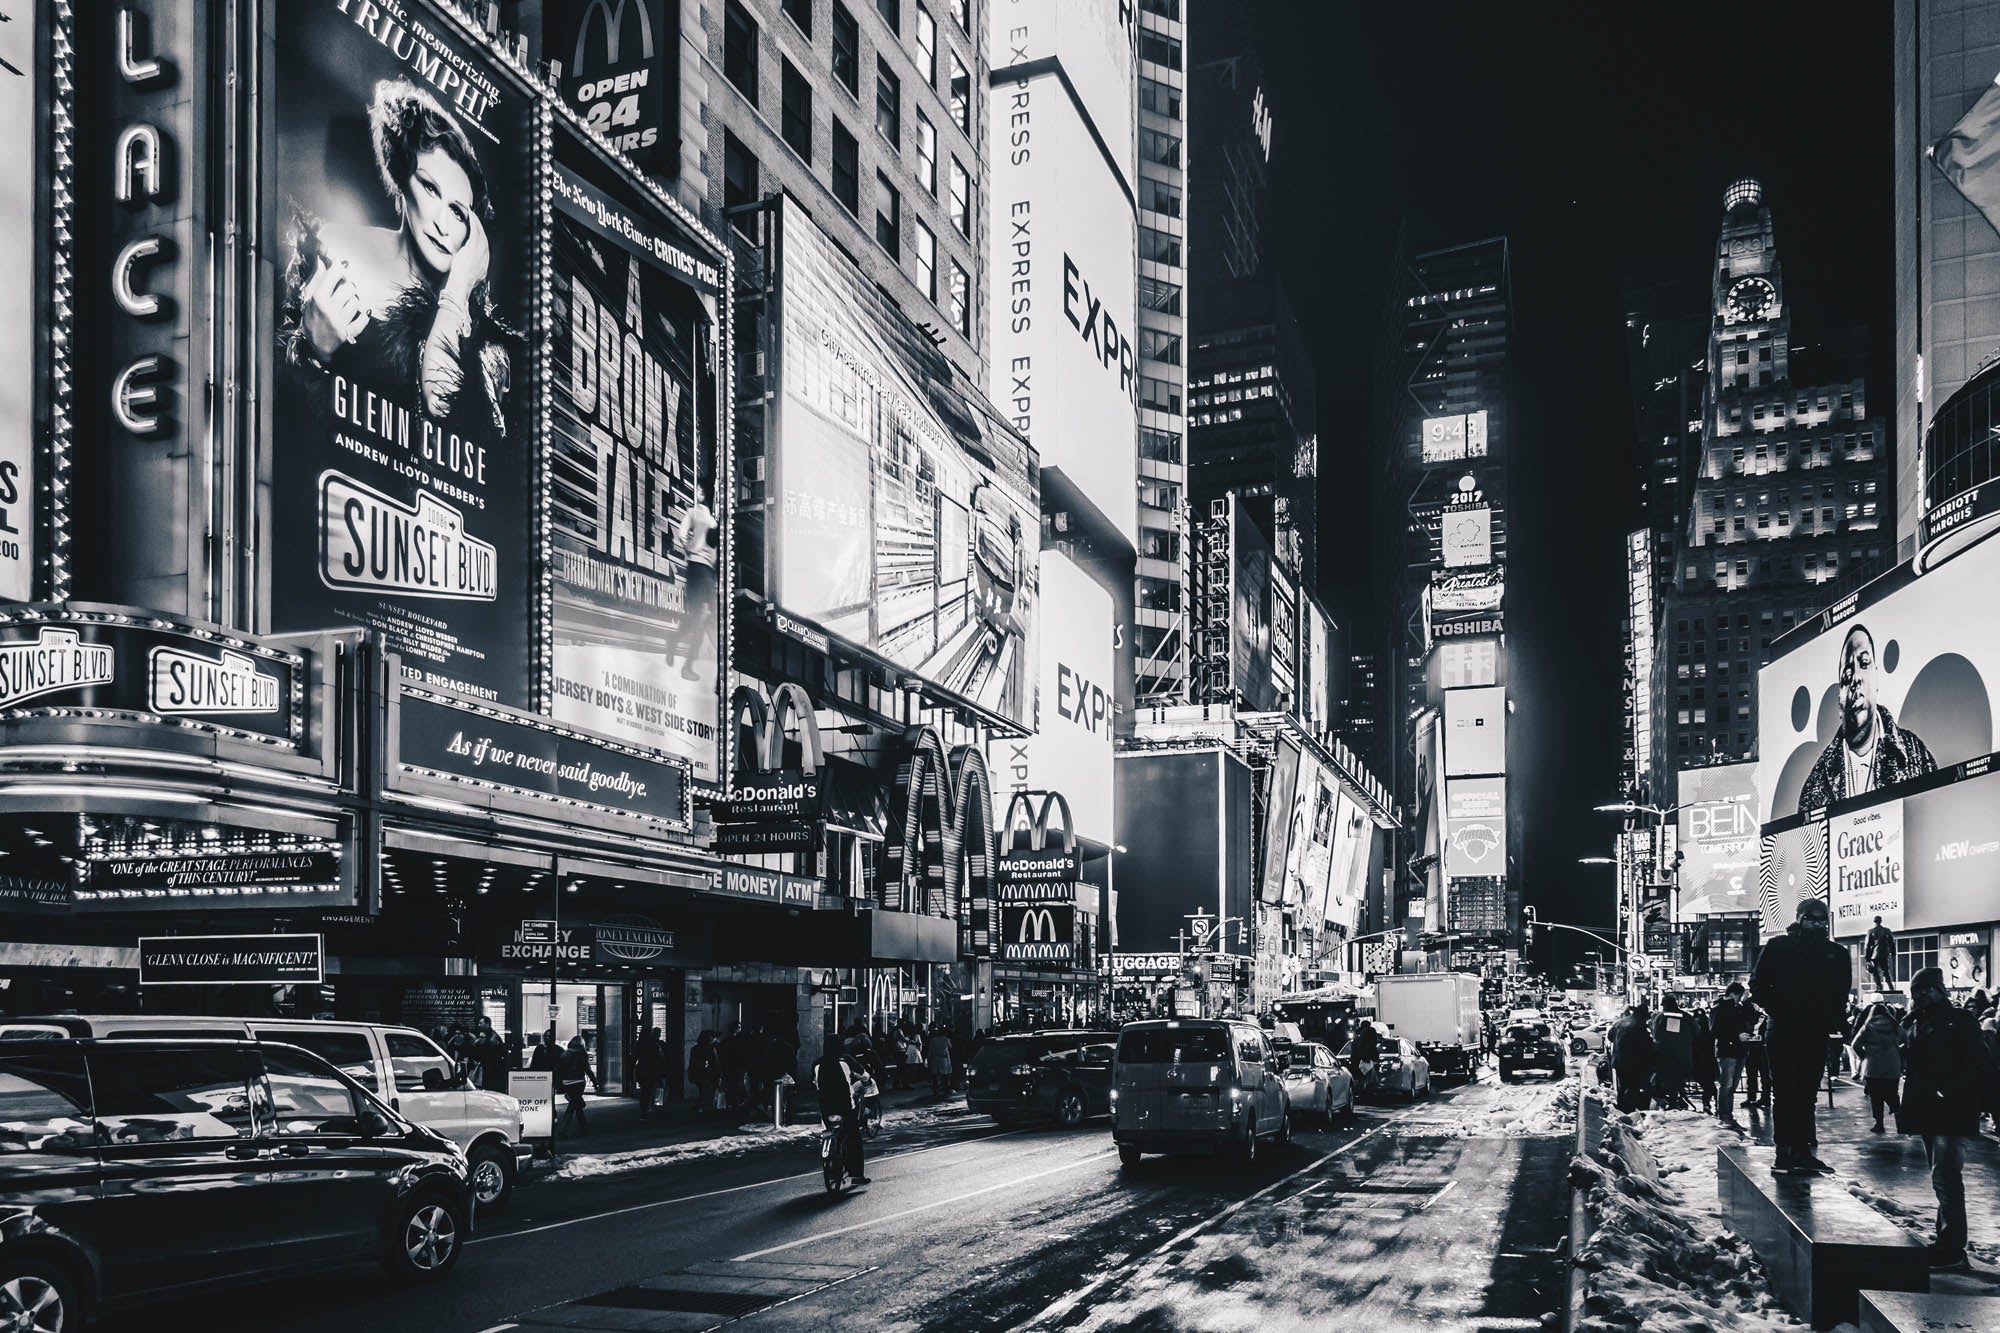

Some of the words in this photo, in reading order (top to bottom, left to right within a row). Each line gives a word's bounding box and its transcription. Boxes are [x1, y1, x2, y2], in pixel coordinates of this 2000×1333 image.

[578, 69, 648, 102] OPEN
[587, 94, 640, 133] 24
[610, 128, 657, 151] URS
[553, 171, 573, 199] The
[573, 184, 596, 215] New
[597, 200, 623, 233] York
[623, 215, 653, 251] Times
[654, 237, 695, 276] CRITICS'
[696, 260, 719, 288] PICK
[1012, 200, 1031, 334] EXPRESS
[625, 254, 643, 340] A
[1064, 251, 1138, 410] EXPR
[572, 275, 680, 480] BRONX
[1012, 356, 1031, 441] EXPR
[336, 376, 410, 450] GLENN
[423, 420, 486, 486] CLOSE
[336, 433, 389, 466] ANDREW
[394, 459, 430, 485] LLOYD
[434, 477, 485, 511] WEBBER'S
[411, 454, 419, 465] in
[590, 423, 670, 577] TALE
[1443, 501, 1489, 513] TOSHIBA
[1451, 490, 1483, 505] 2017
[1930, 490, 1979, 523] MARRIOTT
[1930, 506, 1973, 536] MARQUIS
[344, 498, 451, 588] SUNSET
[458, 541, 494, 594] BLVD.
[378, 601, 407, 617] SUNSET
[407, 611, 448, 630] BOULEVARD
[1832, 593, 1859, 614] MARRIOTT
[1832, 604, 1856, 624] MARQUIS
[387, 616, 414, 630] ANDREW
[415, 625, 435, 637] LLOYD
[435, 633, 458, 644] WEBBER
[388, 625, 409, 637] BLACK
[1432, 619, 1504, 637] TOSHIBA
[0, 649, 67, 697] SUNSET
[74, 647, 111, 681] BLVD.
[169, 660, 248, 705] SUNSET
[251, 678, 278, 709] BLVD.
[426, 672, 499, 702] ENGAGEMENT
[611, 674, 667, 706] COMBINATION
[668, 692, 678, 710] OF
[553, 677, 597, 702] JERSEY
[596, 690, 624, 714] BOYS
[625, 700, 634, 716] &
[635, 702, 663, 726] WEST
[664, 711, 685, 733] SIDE
[447, 731, 470, 757] As
[473, 738, 492, 766] if
[491, 749, 513, 766] we
[516, 753, 558, 777] never
[557, 762, 589, 784] said
[590, 771, 648, 800] goodbye.
[733, 783, 817, 802] cDonald's
[731, 802, 799, 814] Restaurant
[1853, 816, 1866, 826] Good
[1867, 812, 1882, 822] vibes.
[720, 834, 750, 844] OPEN
[769, 830, 810, 842] HOURS
[1837, 829, 1884, 860] Grace
[1941, 840, 1969, 861] NEW
[134, 864, 145, 878] of
[145, 862, 159, 874] the
[160, 859, 194, 873] GREAT
[195, 858, 228, 872] STAGE
[229, 856, 314, 871] PERFORMANCES
[999, 858, 1075, 871] McDonald's
[1010, 870, 1062, 879] Restaurant
[1838, 856, 1901, 893] Frankie
[167, 873, 178, 887] of
[176, 872, 201, 885] THIS
[726, 872, 778, 896] MONEY
[785, 881, 812, 901] ATM
[1838, 904, 1861, 919] NETFLIX
[1869, 901, 1889, 913] MARCH
[1891, 900, 1898, 910] 24
[502, 944, 591, 959] EXCHANGE
[626, 931, 674, 945] EXCHANGE
[187, 952, 220, 966] CLOSE
[221, 953, 230, 966] is
